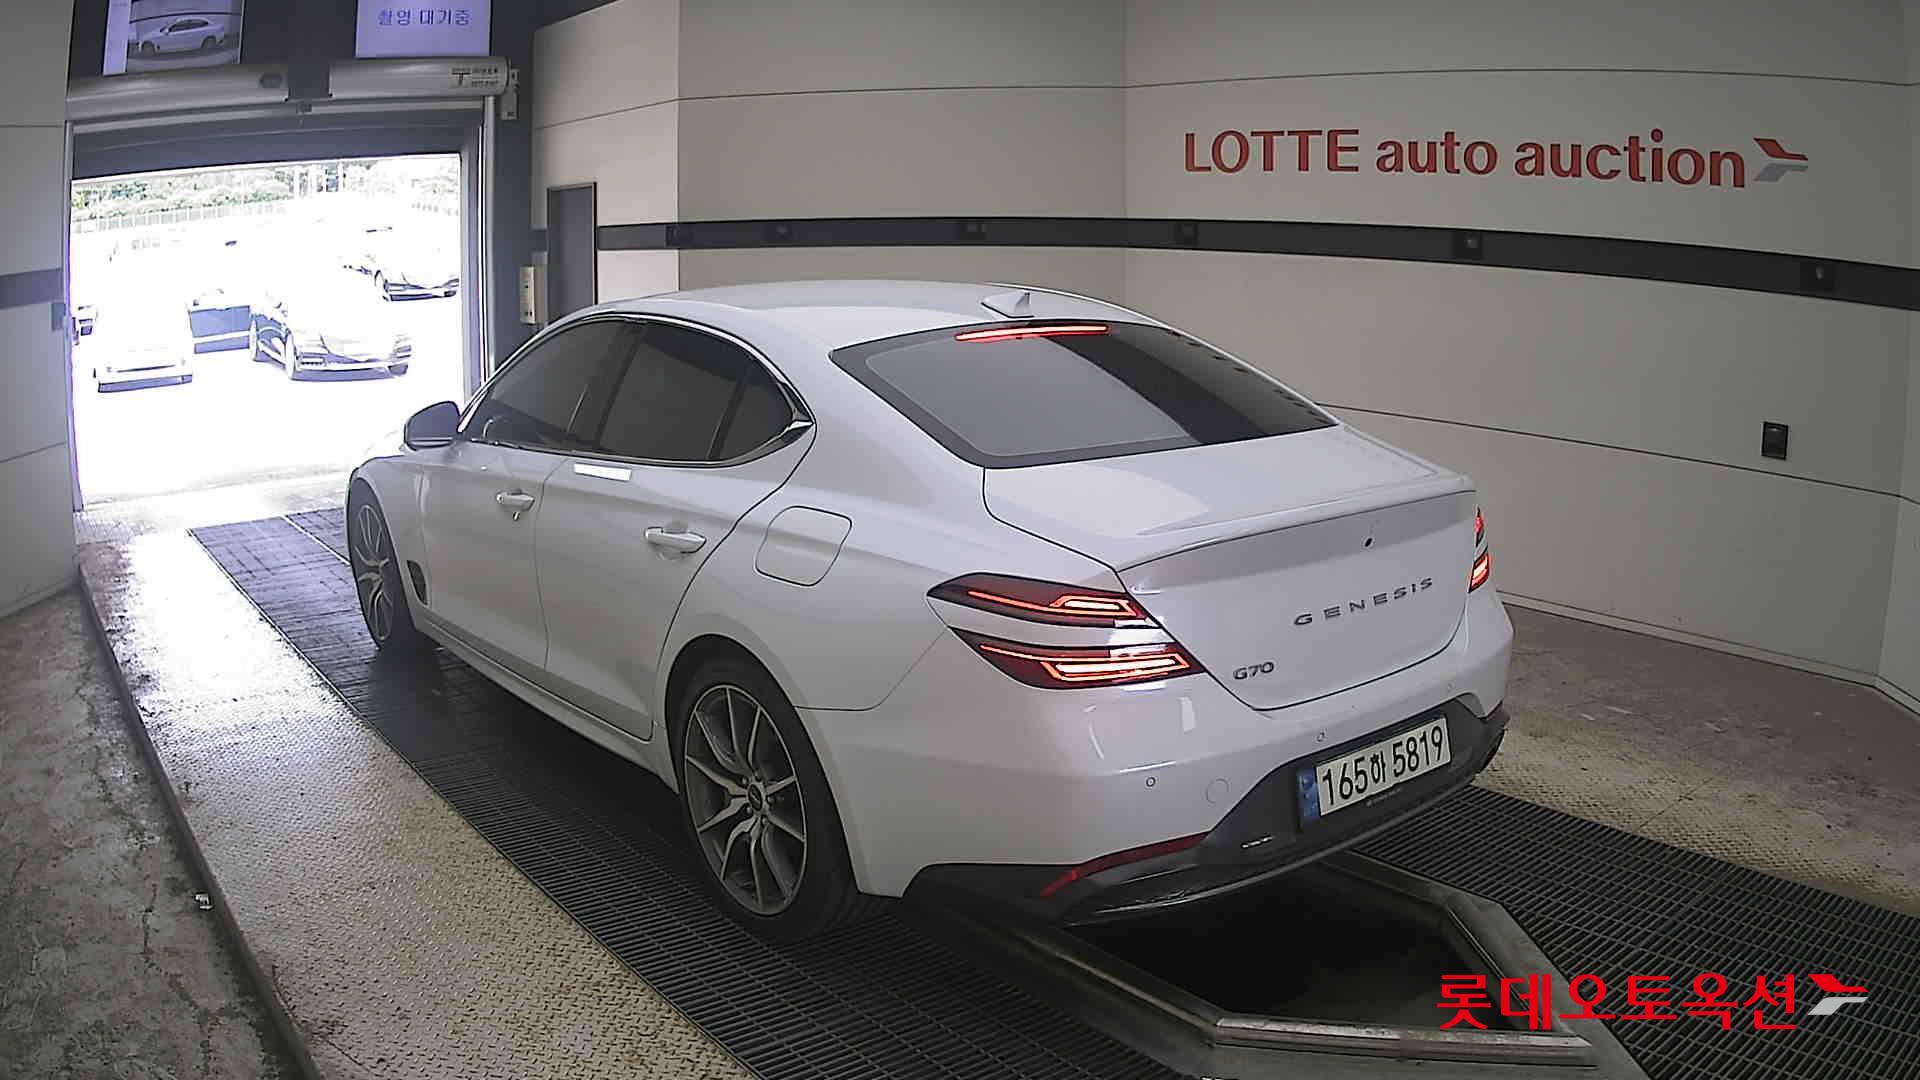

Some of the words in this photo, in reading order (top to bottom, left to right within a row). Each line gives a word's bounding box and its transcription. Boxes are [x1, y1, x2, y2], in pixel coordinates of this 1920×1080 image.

[419, 8, 470, 26] 대기중
[1184, 128, 1360, 174] LOTTE
[1375, 131, 1499, 175] auto
[1513, 128, 1746, 188] auction
[1293, 577, 1433, 626] GENESIS
[1232, 661, 1275, 680] G70
[1322, 750, 1387, 806] 165하
[1391, 725, 1444, 778] 5819
